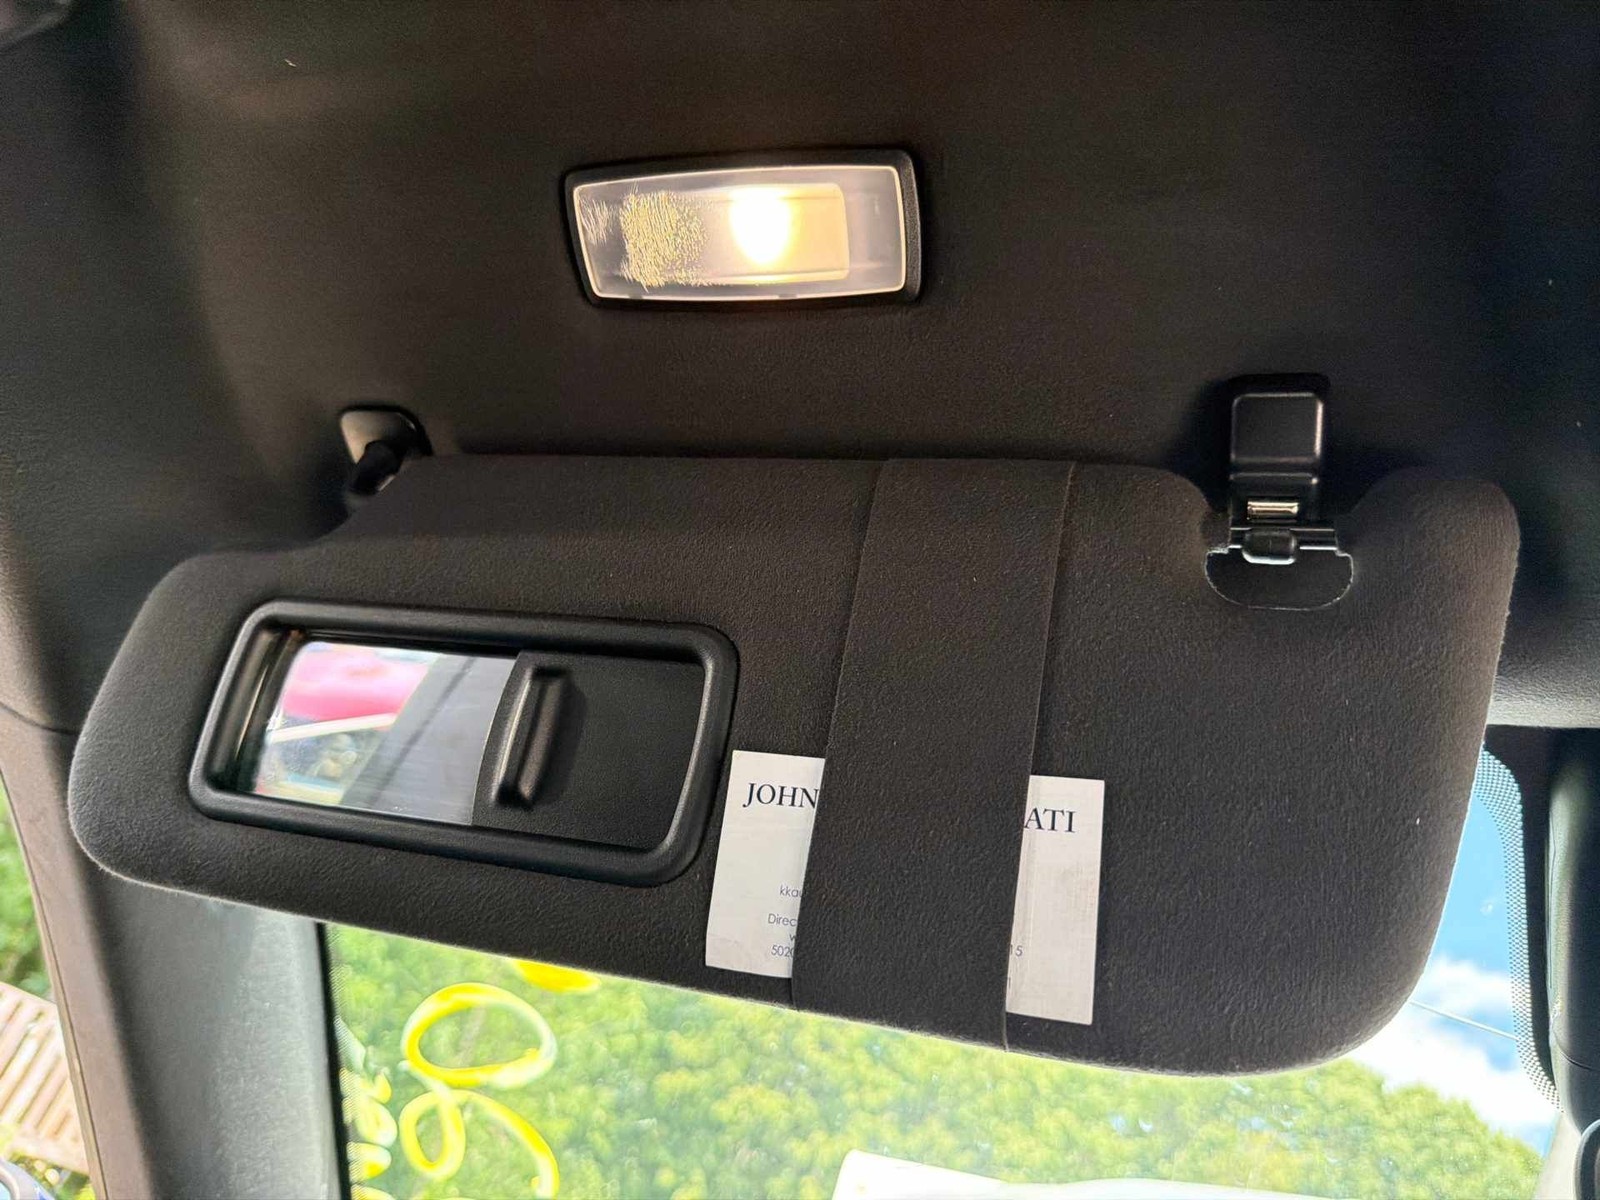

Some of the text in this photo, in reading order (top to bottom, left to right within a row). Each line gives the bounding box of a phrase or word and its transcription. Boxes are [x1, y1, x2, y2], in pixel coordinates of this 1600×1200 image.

[742, 783, 1077, 833] JOHN ATI
[768, 913, 798, 927] Direc
